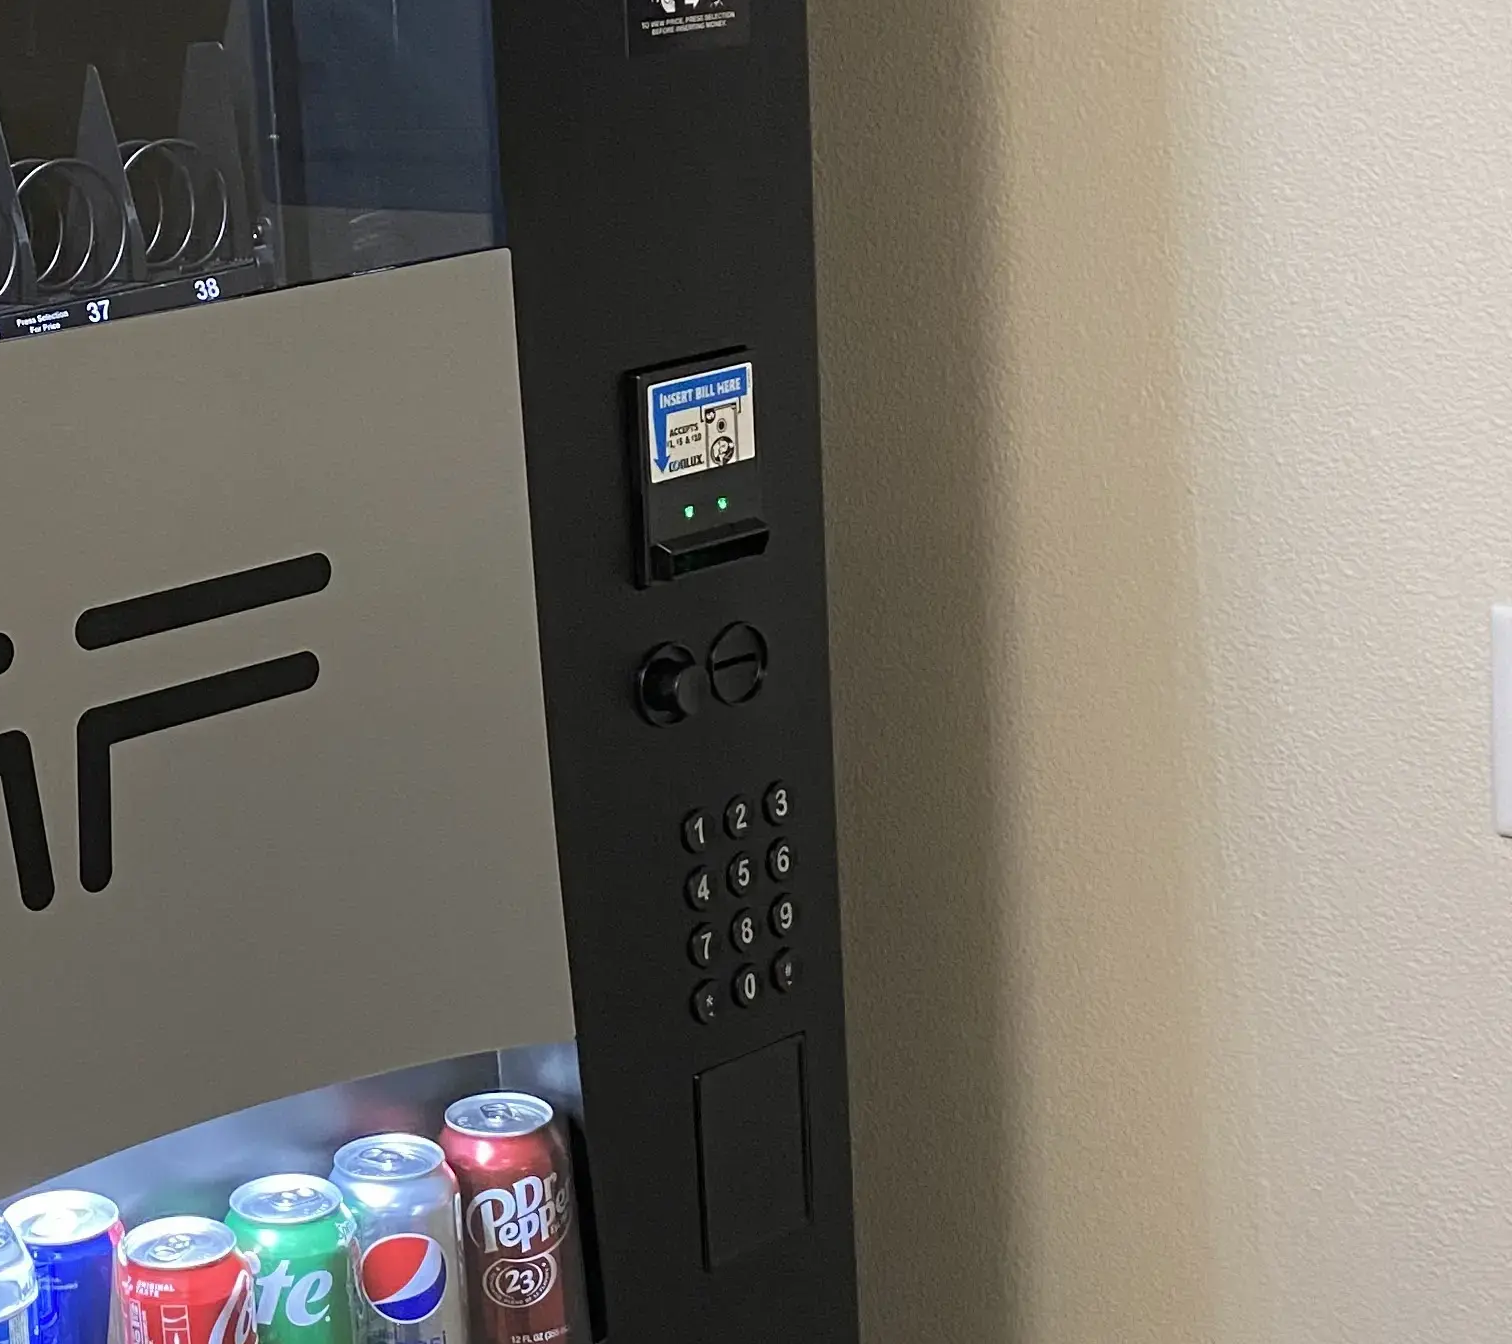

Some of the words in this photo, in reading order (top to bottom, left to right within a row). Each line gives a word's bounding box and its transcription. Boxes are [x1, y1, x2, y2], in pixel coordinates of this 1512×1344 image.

[194, 278, 220, 301] 38
[37, 309, 69, 324] Selection
[86, 299, 111, 324] 37
[43, 321, 61, 333] Price
[659, 389, 694, 409] INSERT
[695, 385, 716, 401] BILL
[717, 377, 741, 395] HERE
[735, 803, 747, 830] 2
[775, 789, 787, 817] 3
[694, 817, 705, 844] 1
[738, 859, 750, 887] 5
[777, 845, 790, 873] 6
[697, 874, 710, 900] 4
[780, 902, 793, 930] 9
[741, 917, 753, 945] 8
[700, 932, 712, 960] 7
[744, 972, 756, 1000] 0
[512, 1171, 558, 1219] Dr
[504, 1268, 535, 1295] 23
